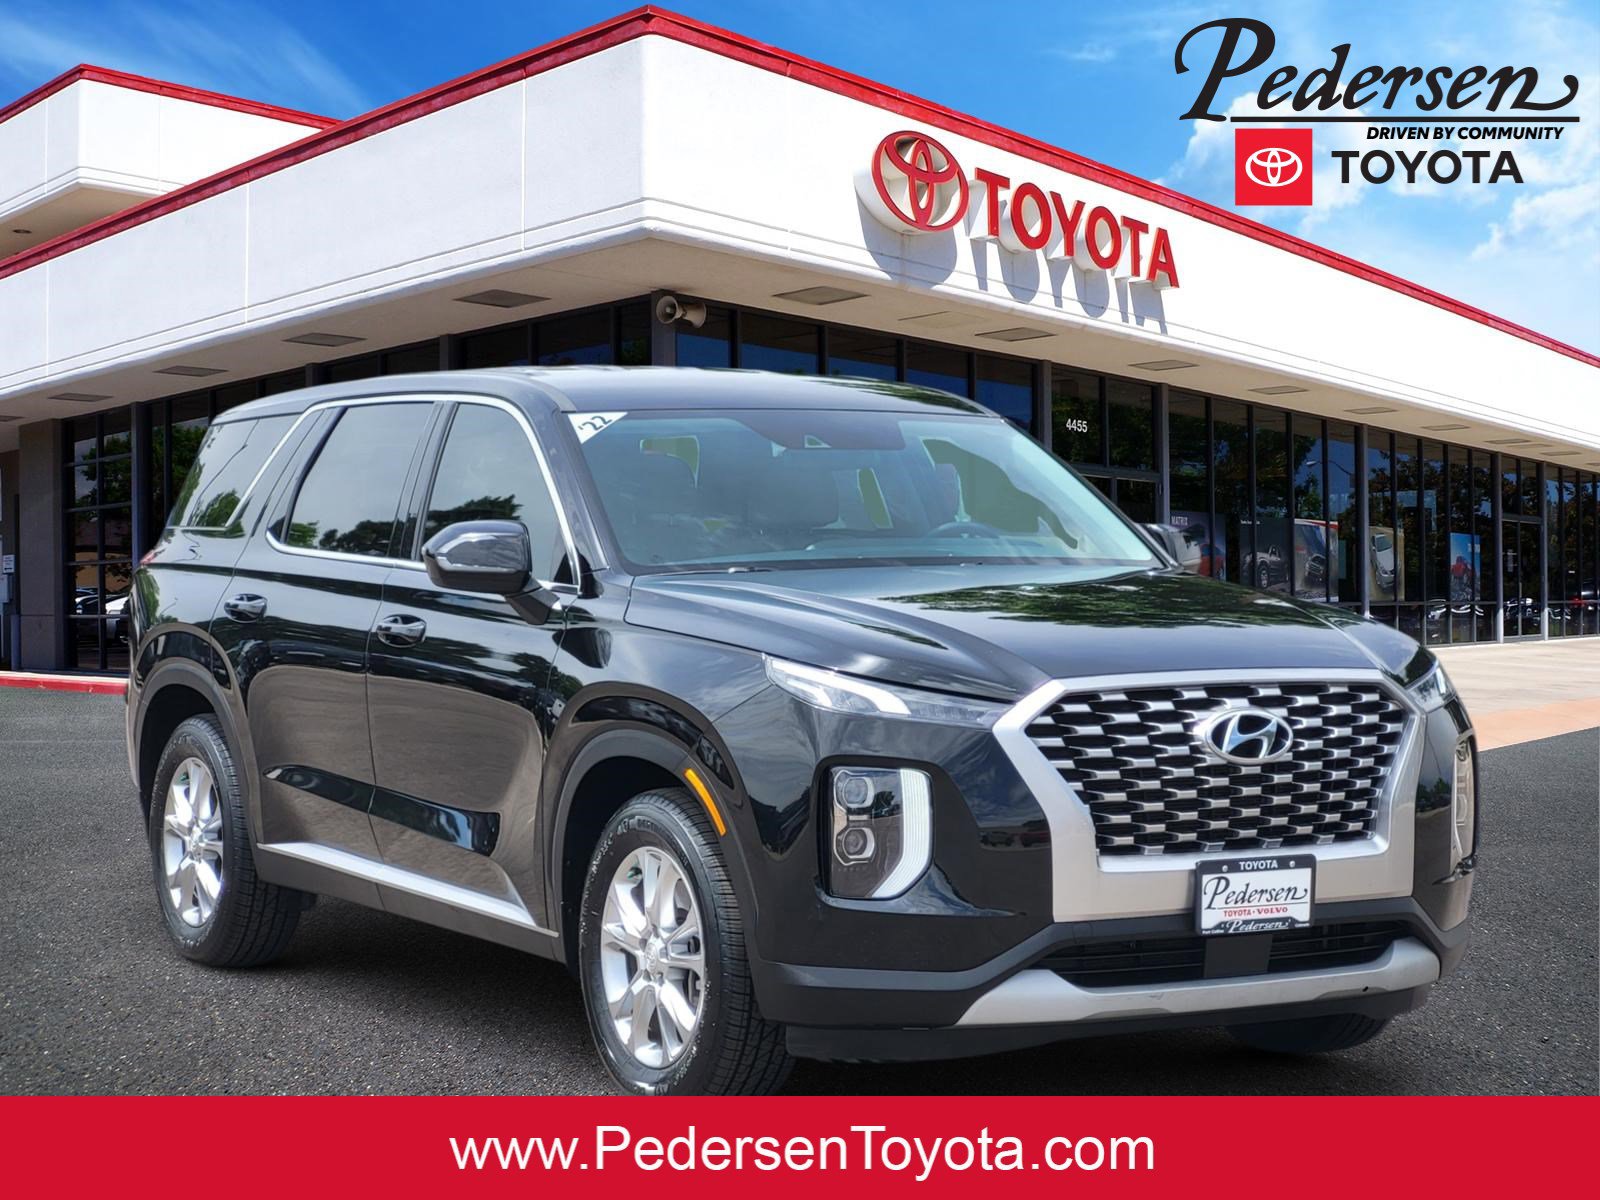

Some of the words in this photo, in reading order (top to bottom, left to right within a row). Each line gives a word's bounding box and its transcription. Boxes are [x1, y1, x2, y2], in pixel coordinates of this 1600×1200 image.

[975, 167, 1180, 288] TOYOTA
[1065, 418, 1088, 433] 4455
[1239, 860, 1278, 871] TOYOTA
[1203, 876, 1308, 910] Pedersen
[1257, 906, 1288, 914] VOLVO
